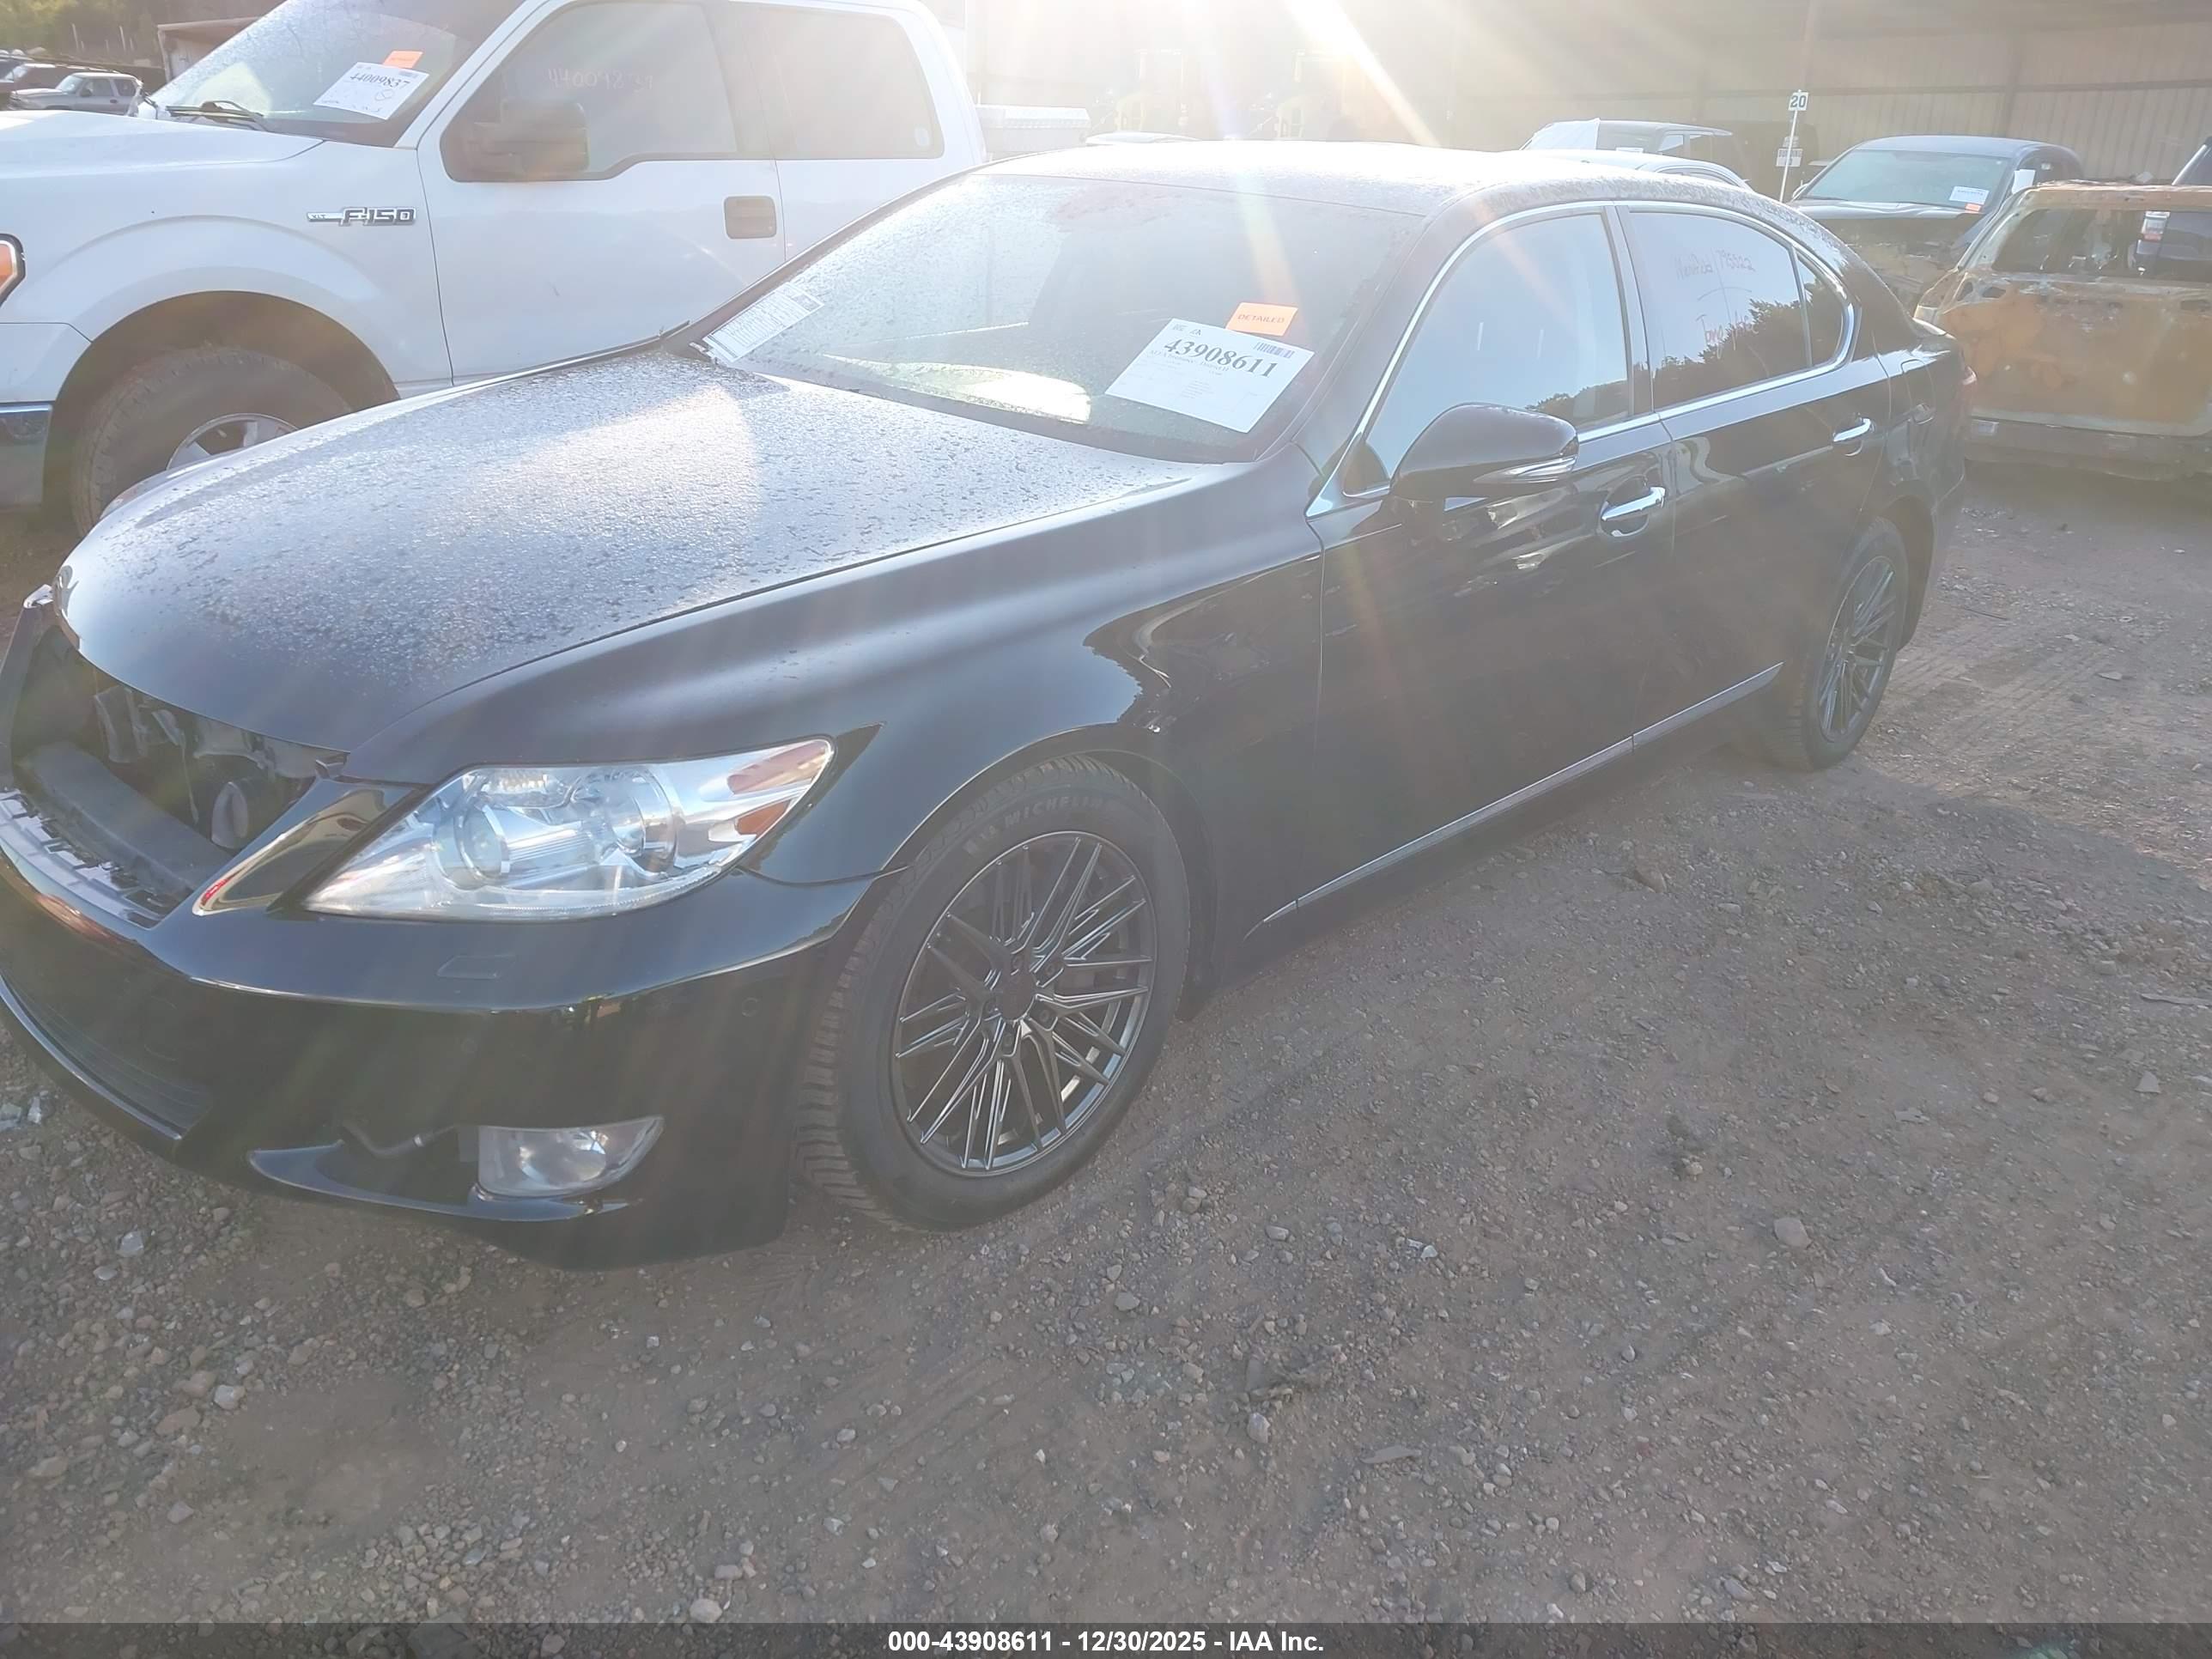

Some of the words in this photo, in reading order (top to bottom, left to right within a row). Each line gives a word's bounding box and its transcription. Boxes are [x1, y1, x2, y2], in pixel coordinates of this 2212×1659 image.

[349, 72, 411, 89] 44009837
[1790, 94, 1807, 108] 20
[1237, 314, 1285, 324] DETAILED
[1164, 338, 1279, 378] 43908611
